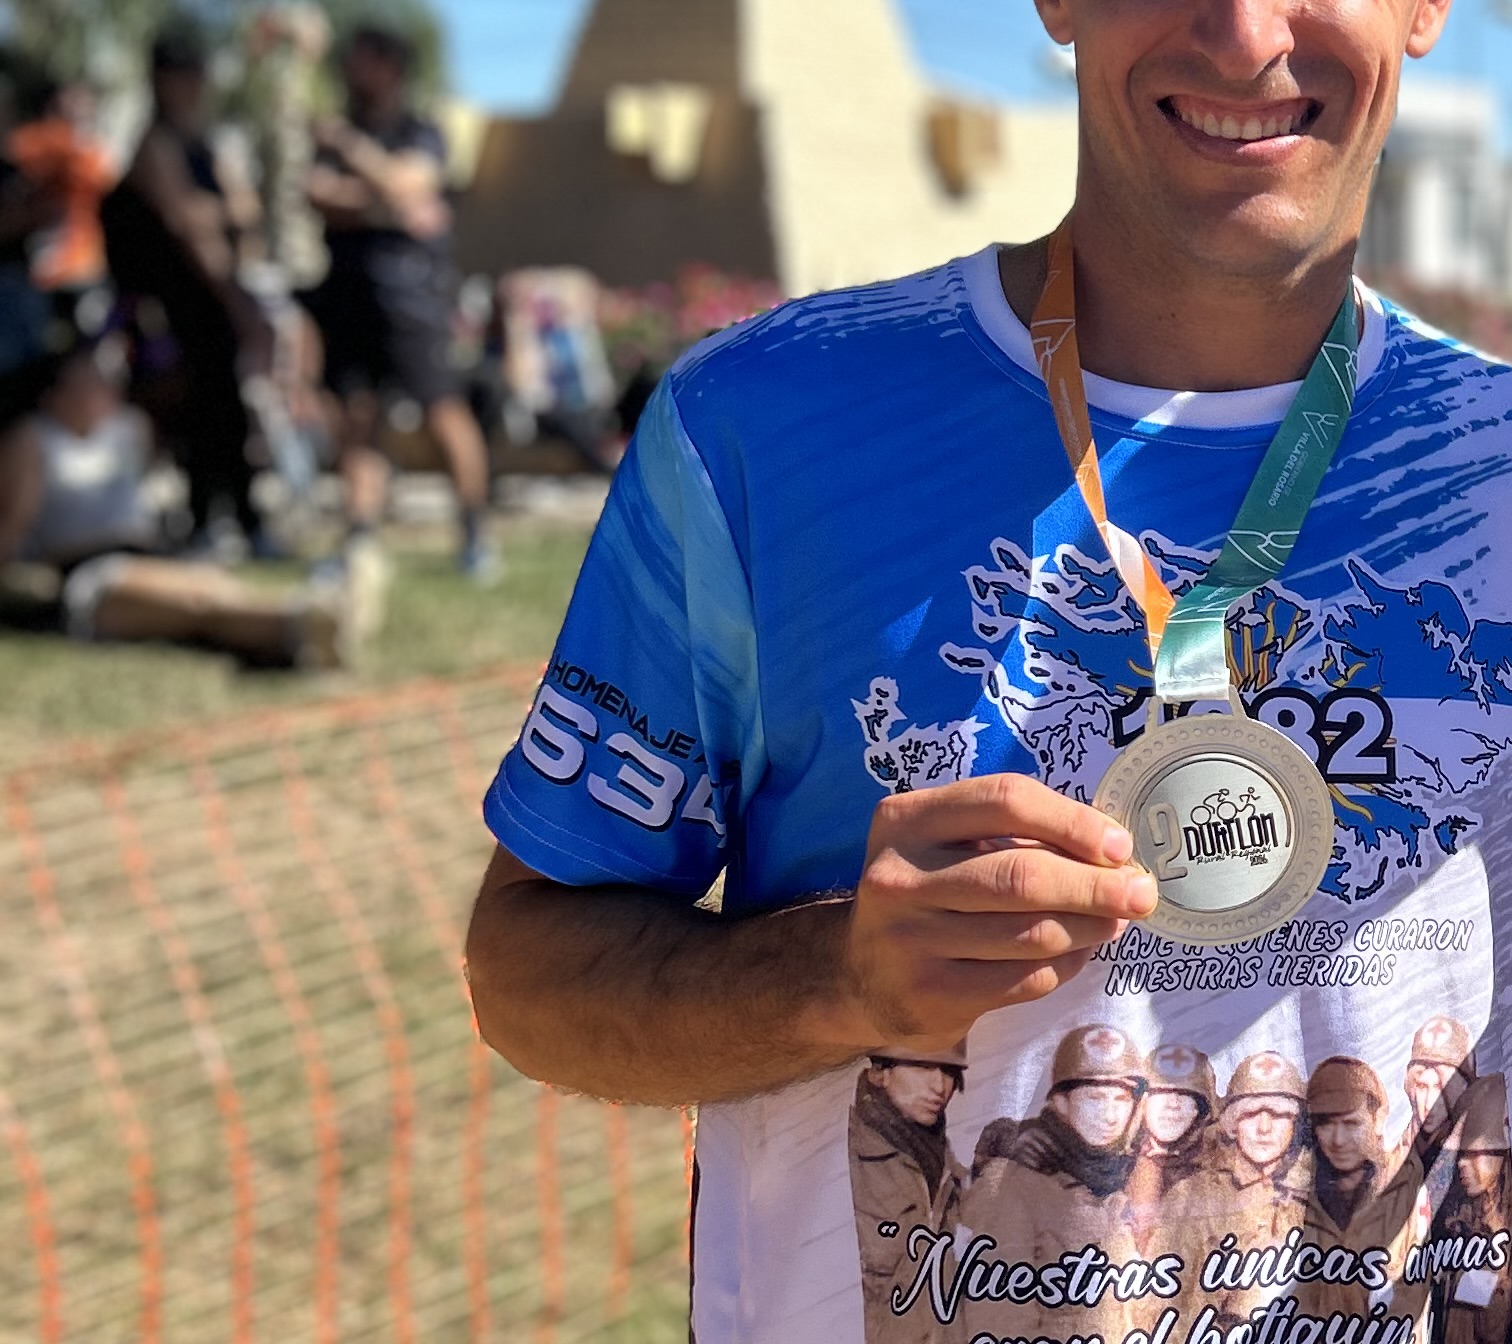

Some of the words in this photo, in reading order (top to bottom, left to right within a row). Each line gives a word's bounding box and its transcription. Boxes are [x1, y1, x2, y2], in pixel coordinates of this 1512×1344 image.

[1284, 453, 1299, 470] DEL
[1292, 431, 1311, 455] VILLA
[1267, 469, 1291, 507] ROSARIO
[551, 659, 697, 760] HOMENAJE
[1146, 801, 1189, 882] 2
[1353, 918, 1475, 952] CURARON
[1105, 955, 1264, 998] NUESTRAS
[1267, 954, 1398, 988] HERIDAS
[1201, 1226, 1392, 1292] únicas
[1405, 1229, 1511, 1286] armas
